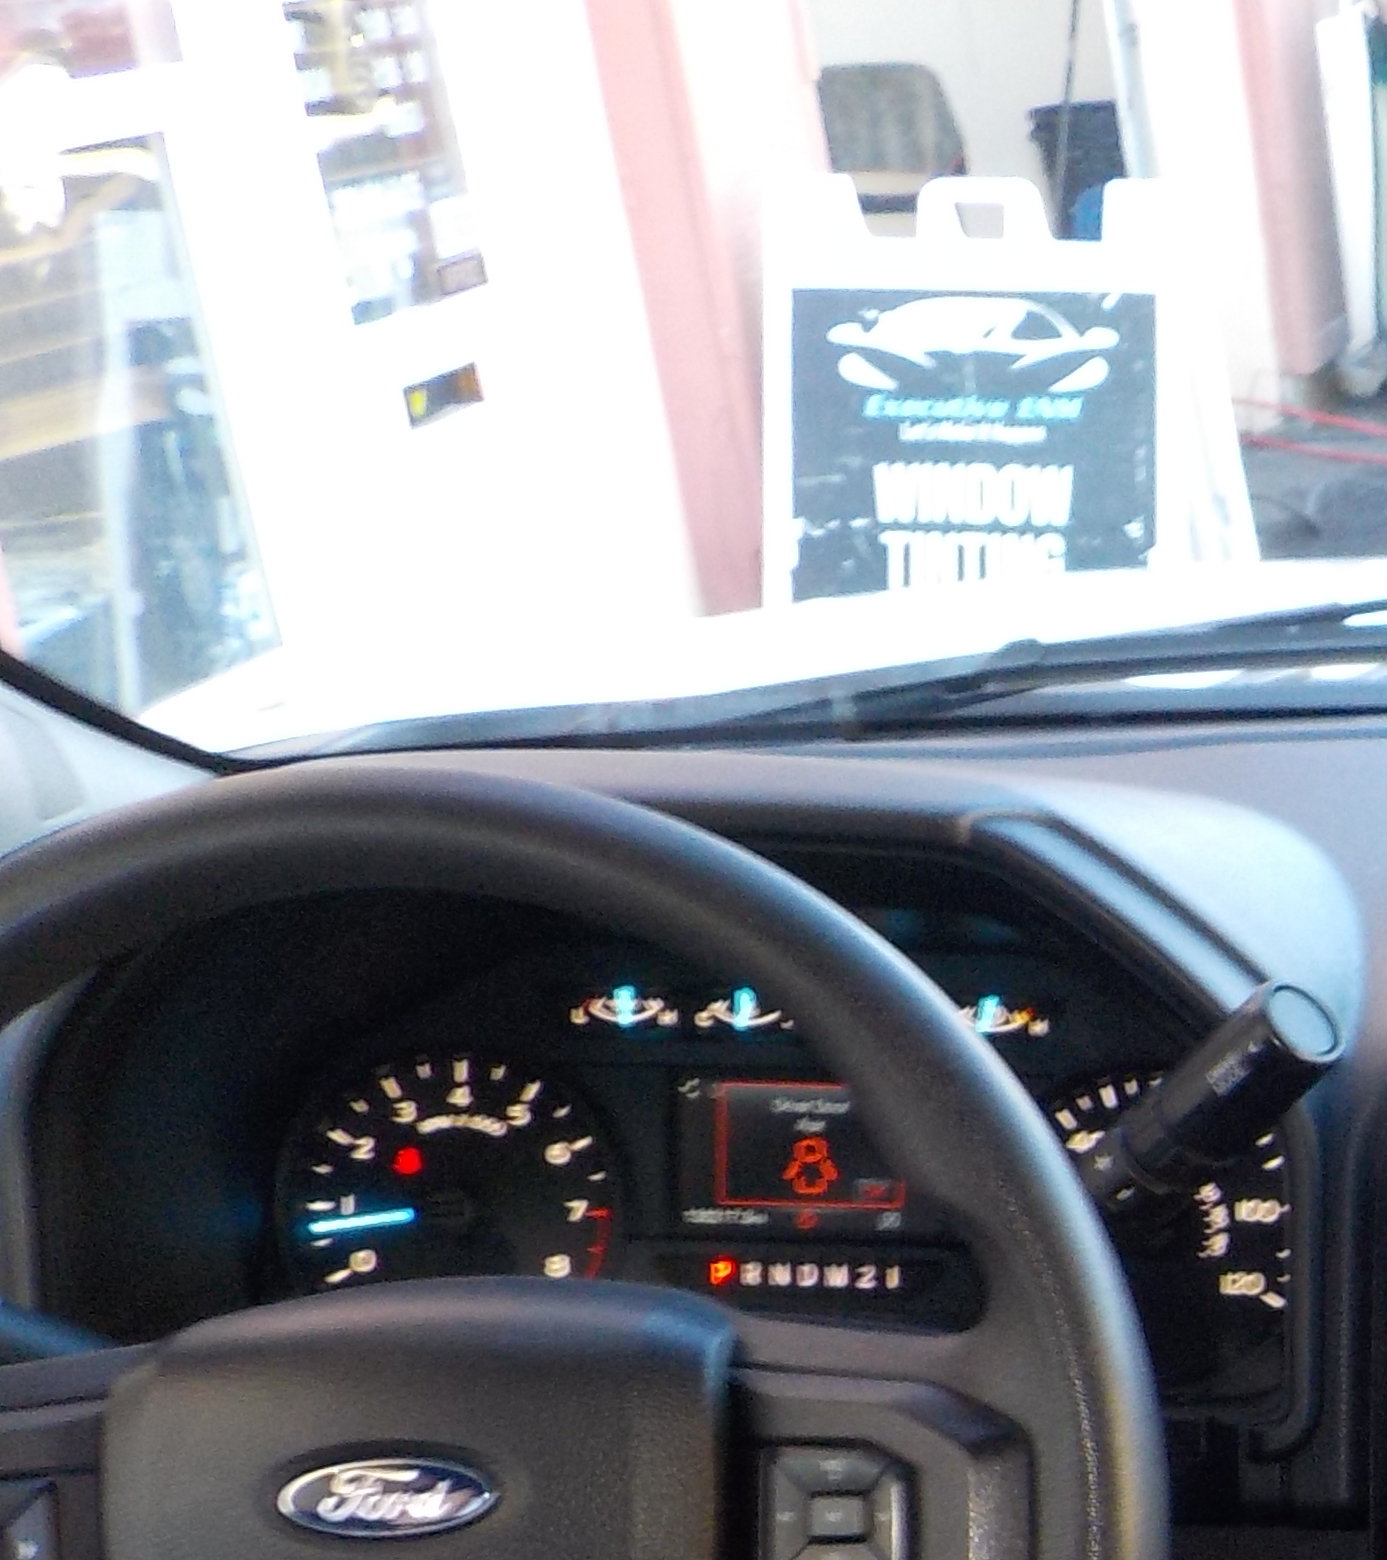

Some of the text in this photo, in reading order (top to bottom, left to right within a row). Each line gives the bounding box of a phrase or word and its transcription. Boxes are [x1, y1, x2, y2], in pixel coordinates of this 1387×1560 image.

[872, 461, 1074, 526] WINDOW
[446, 1085, 473, 1107] 4
[391, 1100, 418, 1124] 3
[506, 1103, 532, 1127] 5
[350, 1136, 376, 1160] 2
[544, 1141, 572, 1165] 6
[564, 1199, 589, 1222] 7
[543, 1254, 571, 1278] 8
[709, 1257, 735, 1286] P
[795, 1262, 819, 1287] D
[853, 1264, 878, 1290] 2
[315, 1468, 454, 1524] Ford
